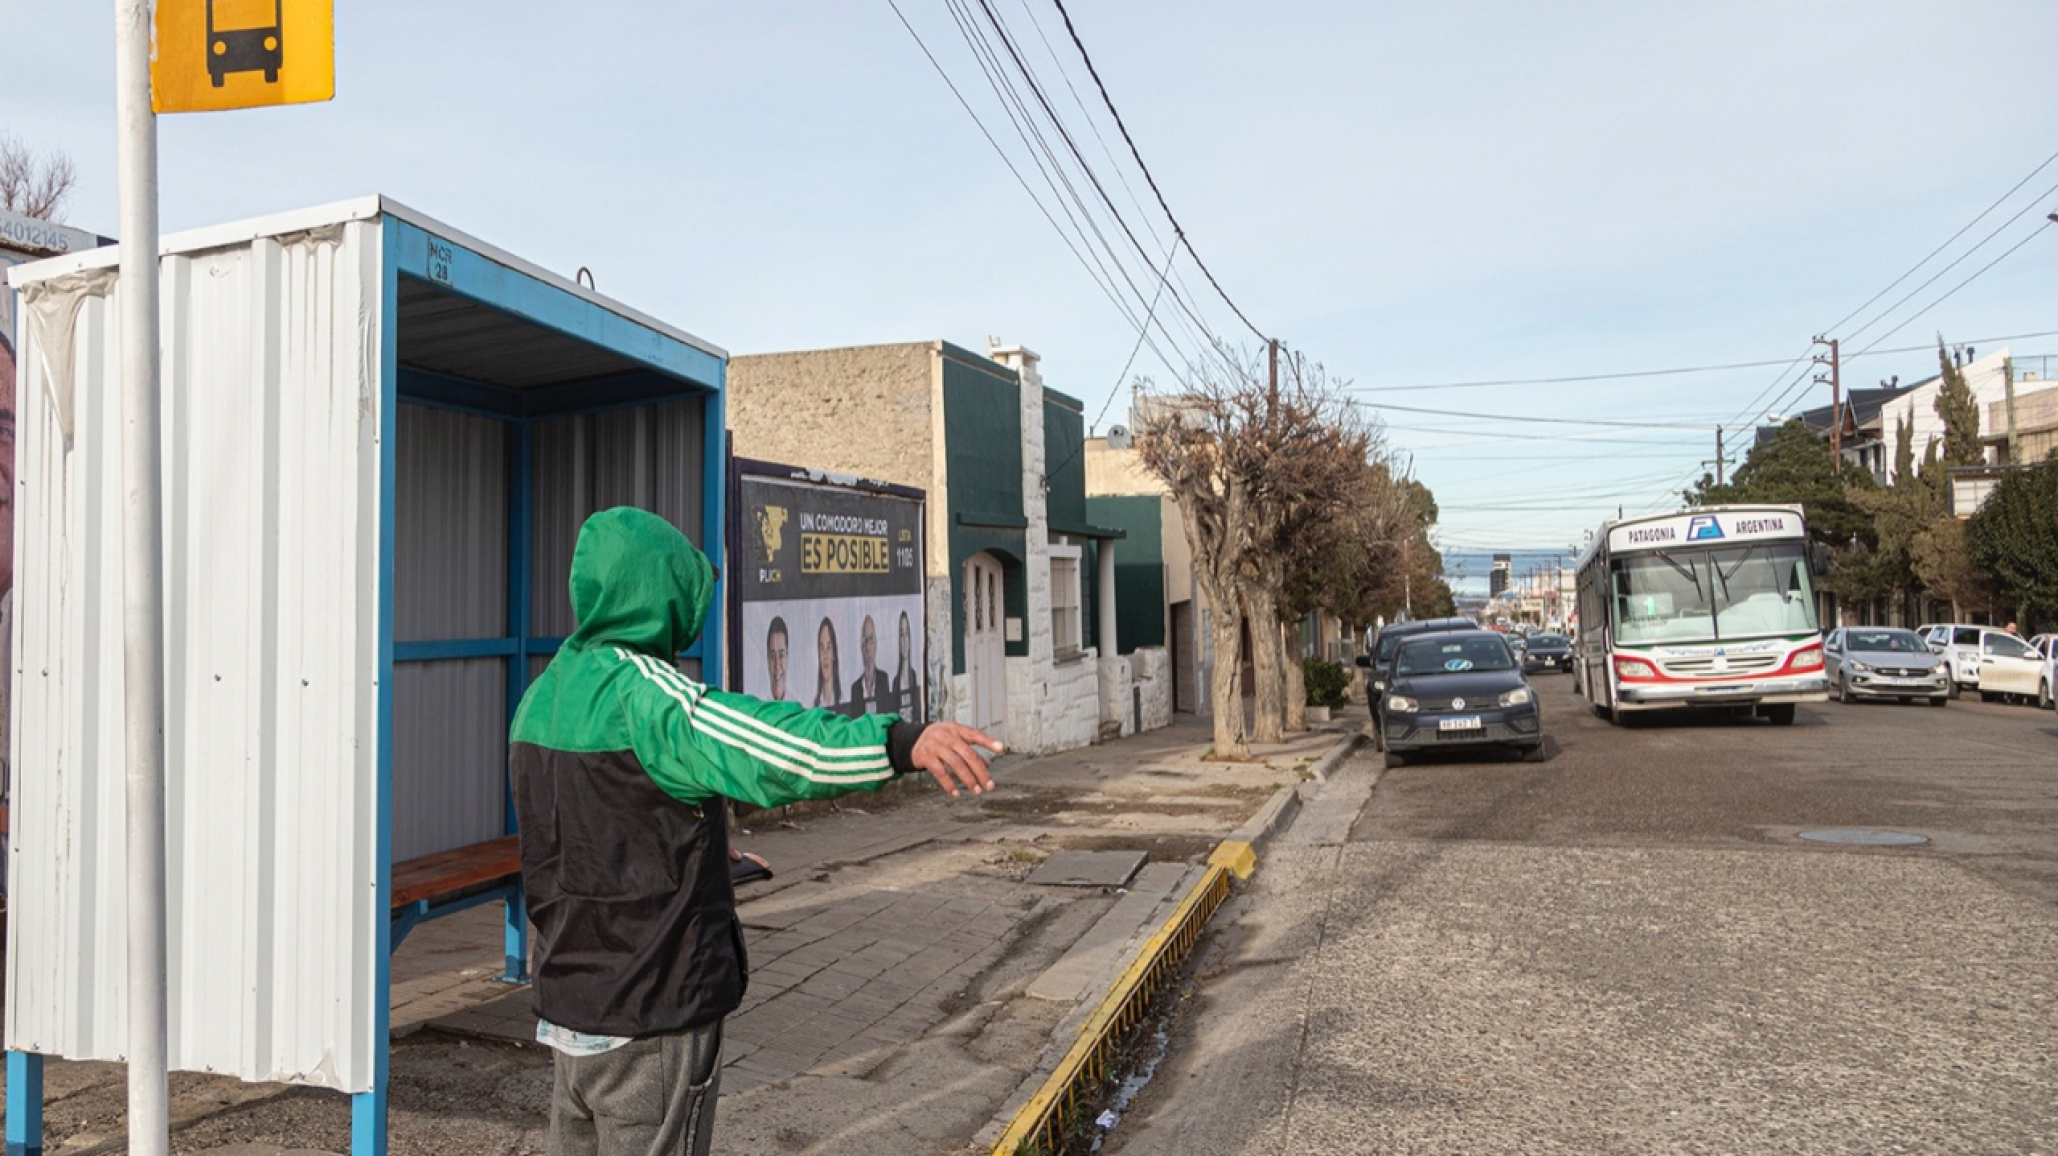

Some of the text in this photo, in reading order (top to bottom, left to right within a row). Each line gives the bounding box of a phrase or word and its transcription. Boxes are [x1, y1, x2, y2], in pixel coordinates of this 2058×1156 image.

[0, 221, 69, 250] 4012145
[800, 512, 888, 535] UN COMODORO MEJOR
[1628, 518, 1784, 544] PATAGONIA ARGENTINA
[803, 537, 889, 570] ES POSIBLE
